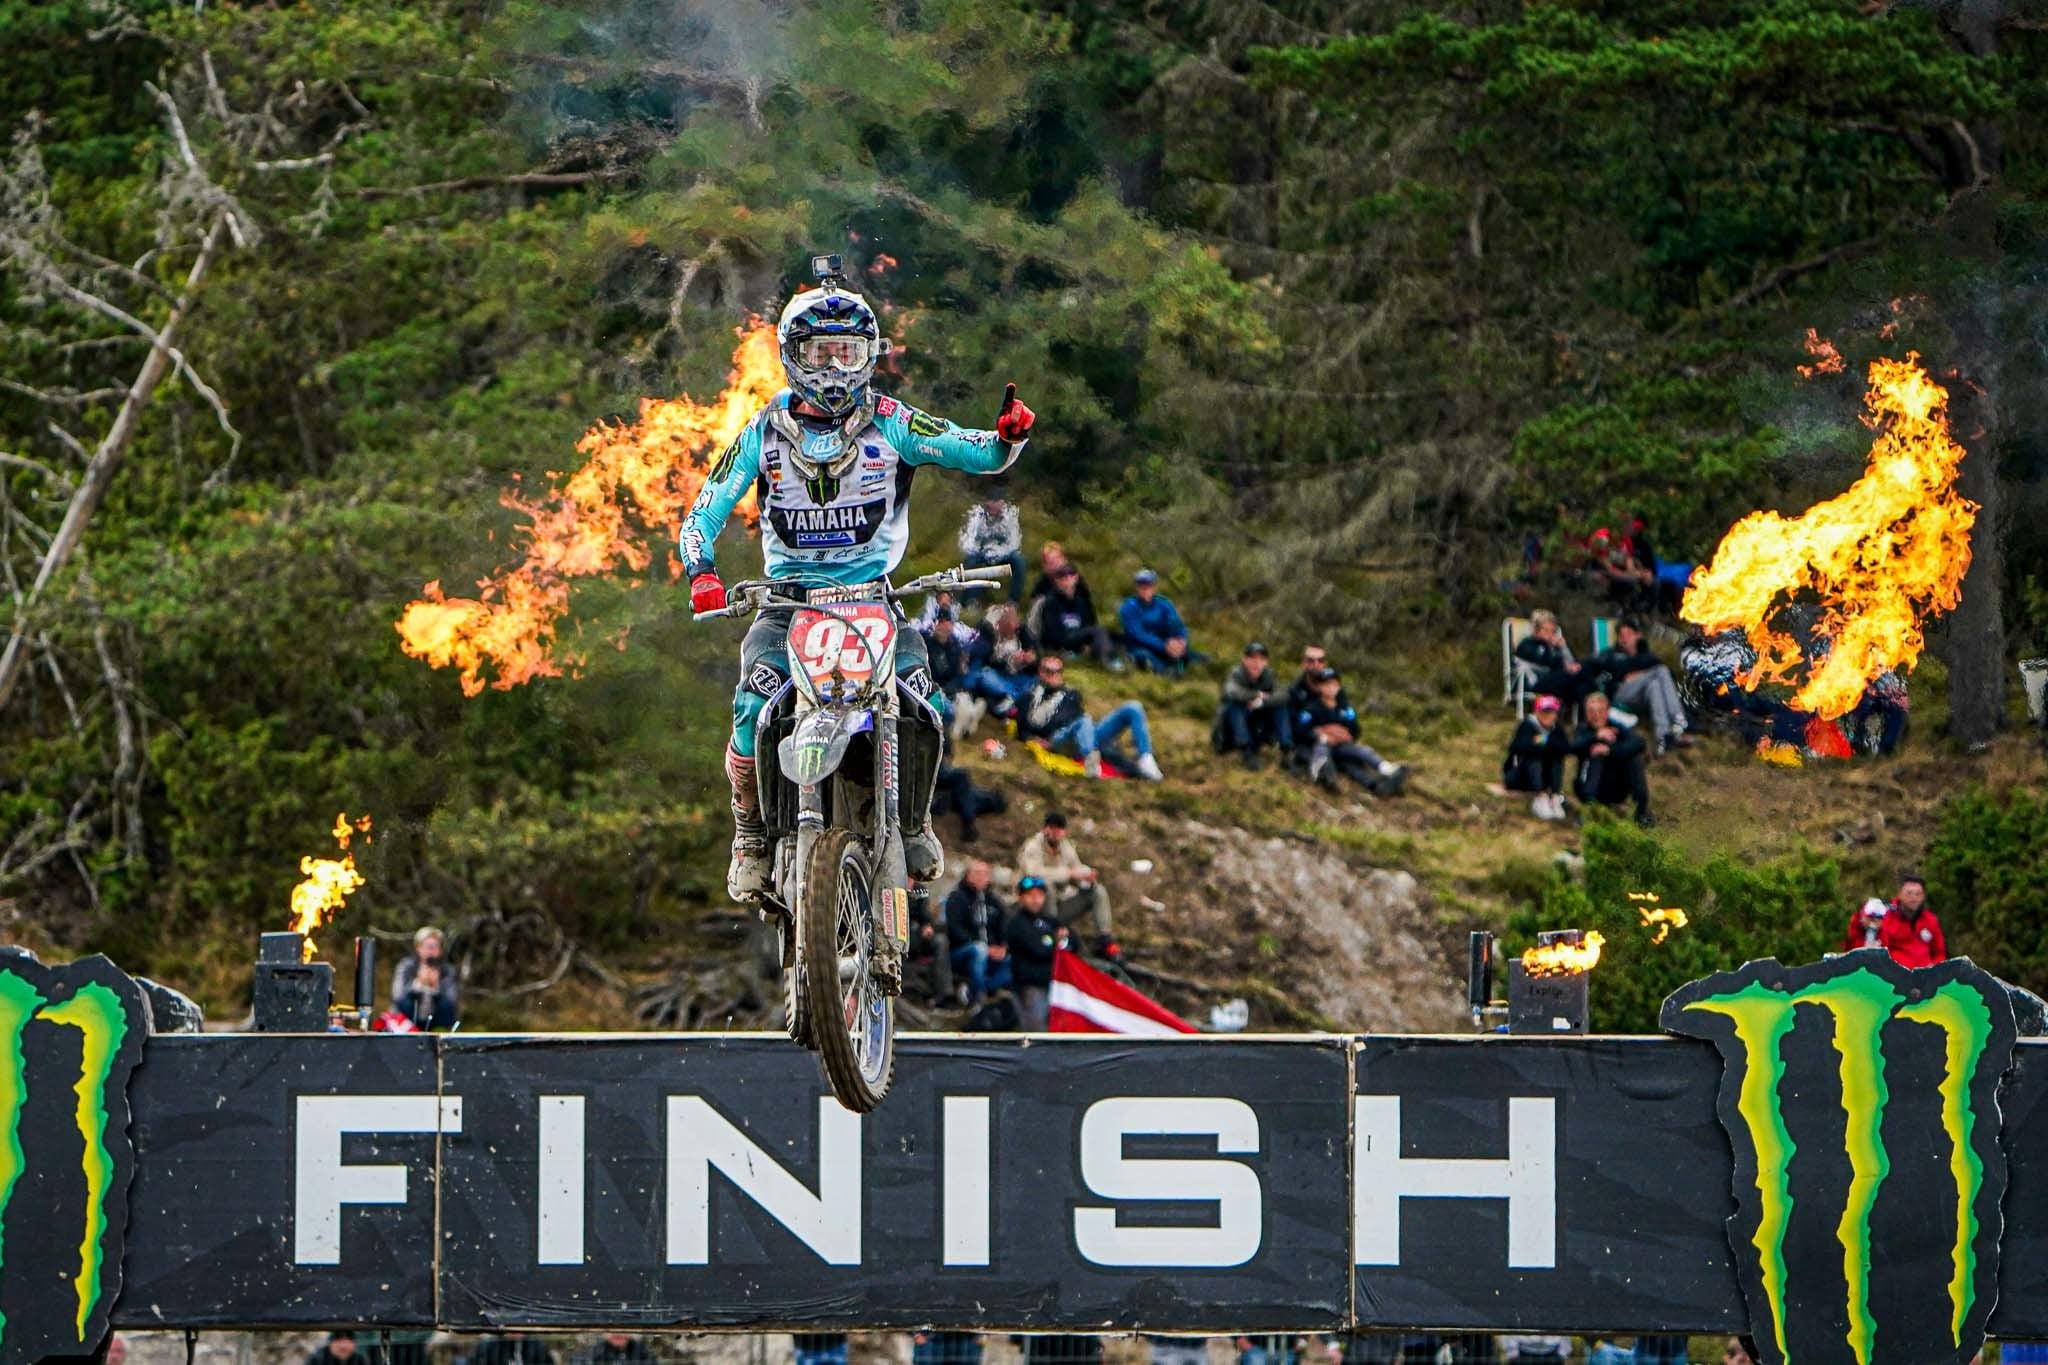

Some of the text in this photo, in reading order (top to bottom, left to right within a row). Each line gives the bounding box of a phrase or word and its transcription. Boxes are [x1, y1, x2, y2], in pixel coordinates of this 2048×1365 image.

[783, 506, 868, 530] YAMAHA
[804, 617, 889, 677] 93
[293, 1094, 1556, 1268] FINISH
